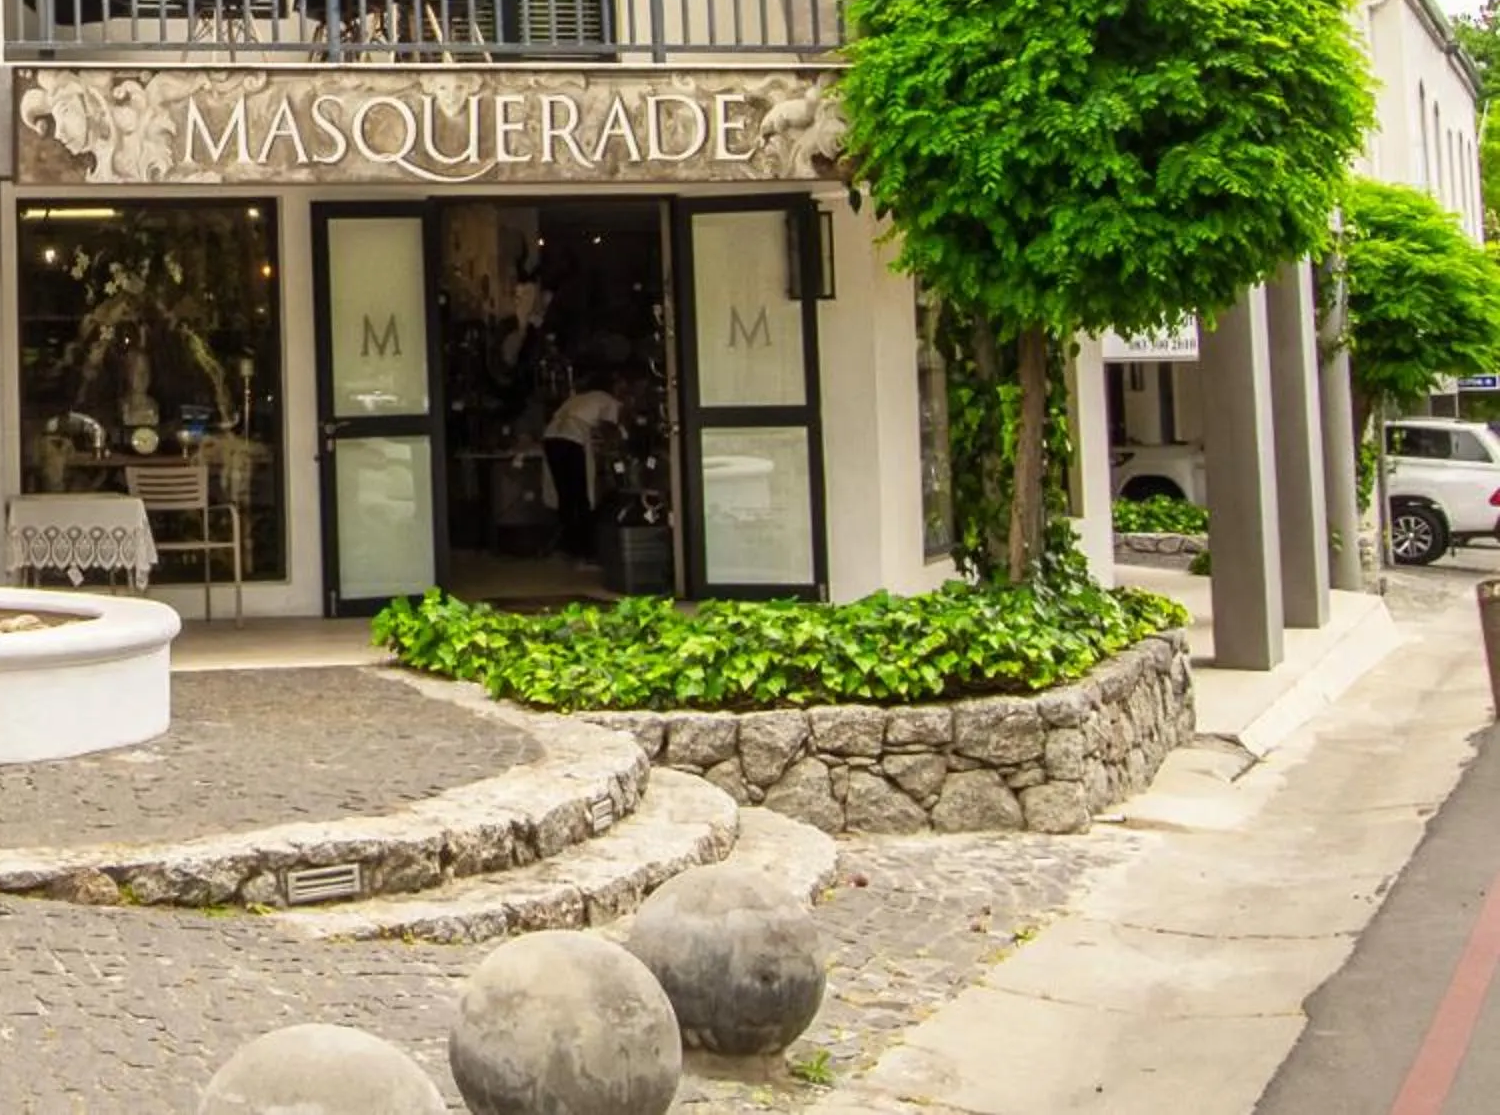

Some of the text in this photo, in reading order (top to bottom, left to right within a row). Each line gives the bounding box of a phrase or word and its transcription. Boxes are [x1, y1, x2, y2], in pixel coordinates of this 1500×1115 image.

[180, 92, 757, 182] MASQUERADE
[360, 313, 402, 357] M
[728, 305, 772, 348] M
